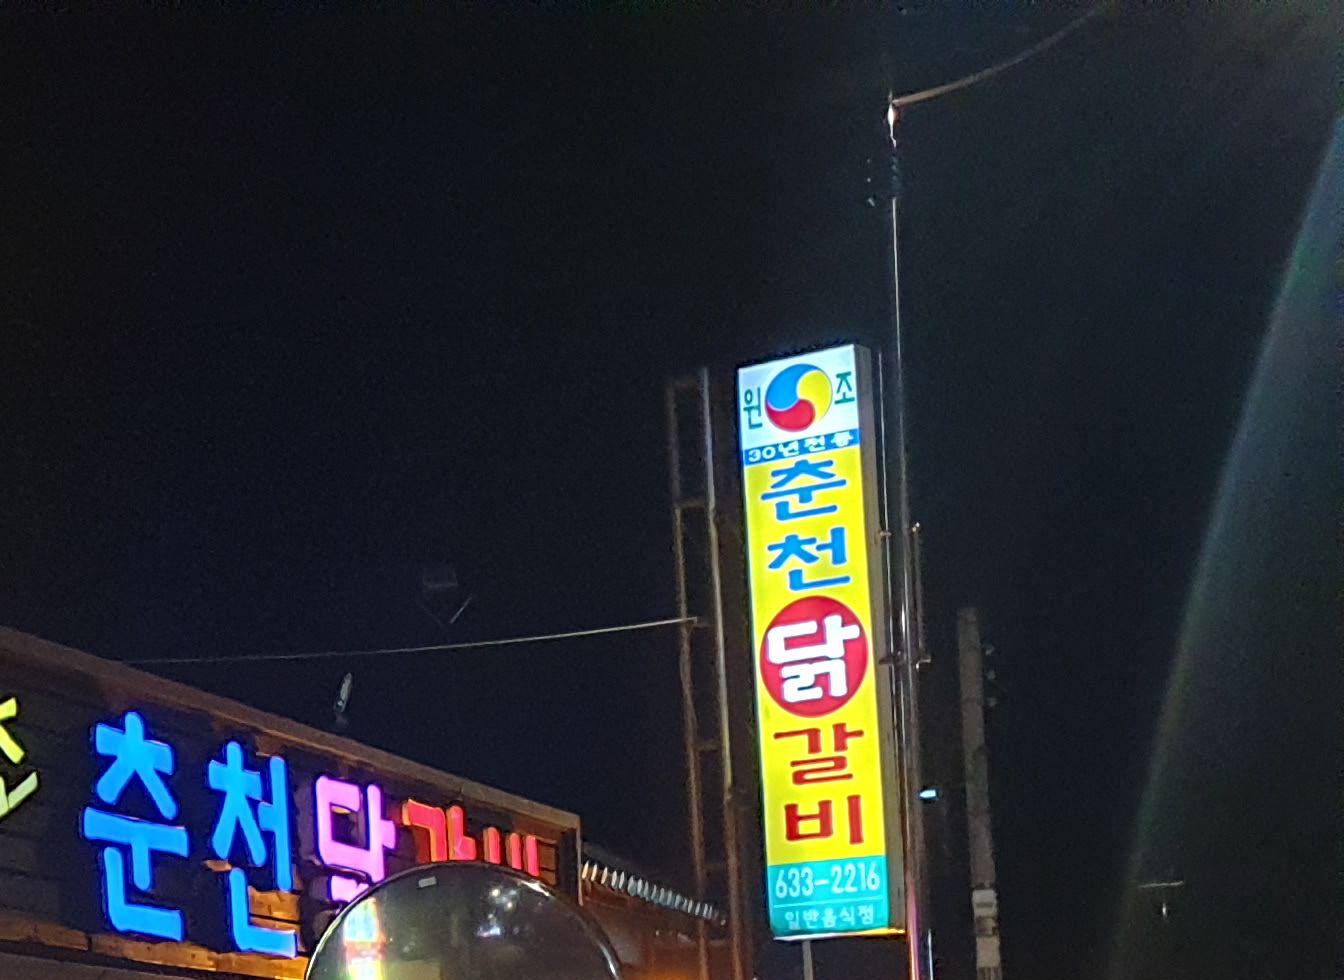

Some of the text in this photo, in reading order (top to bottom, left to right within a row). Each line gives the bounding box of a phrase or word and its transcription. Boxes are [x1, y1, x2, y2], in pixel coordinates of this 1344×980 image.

[748, 431, 854, 463] 30년전통
[760, 459, 848, 592] 춘천
[81, 711, 298, 959] 춘천
[775, 864, 880, 898] 633-2216
[784, 904, 874, 931] 일반음식점
